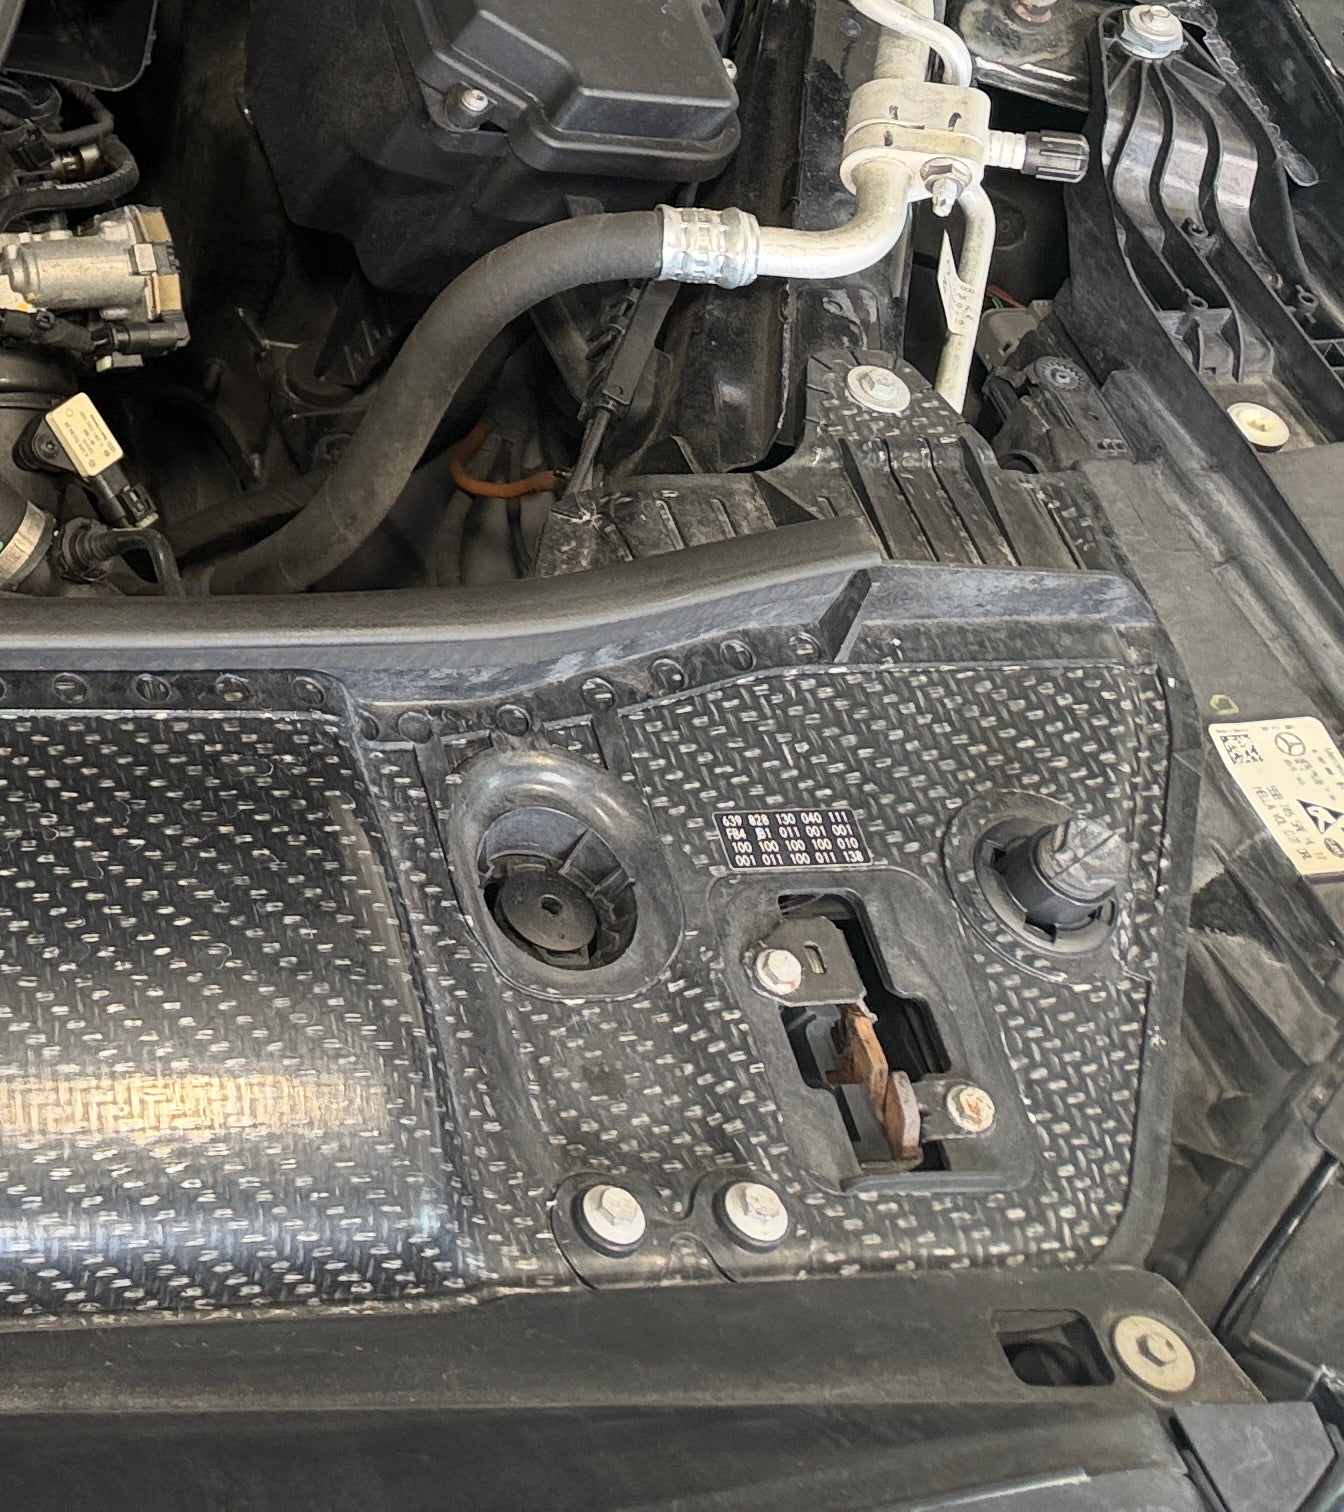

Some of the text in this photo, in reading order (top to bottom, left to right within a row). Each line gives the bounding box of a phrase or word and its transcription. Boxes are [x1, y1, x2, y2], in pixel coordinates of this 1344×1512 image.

[723, 815, 742, 827] 639
[776, 813, 796, 825] 130
[828, 812, 848, 823] 111
[726, 828, 746, 840] FB4
[779, 827, 800, 838] 011
[806, 826, 826, 837] 001
[832, 824, 853, 836] 001
[732, 838, 859, 853] 100 100 100 100 010
[735, 854, 756, 866] 001
[762, 854, 784, 865] 011
[790, 853, 811, 865] 100
[815, 852, 837, 863] 011
